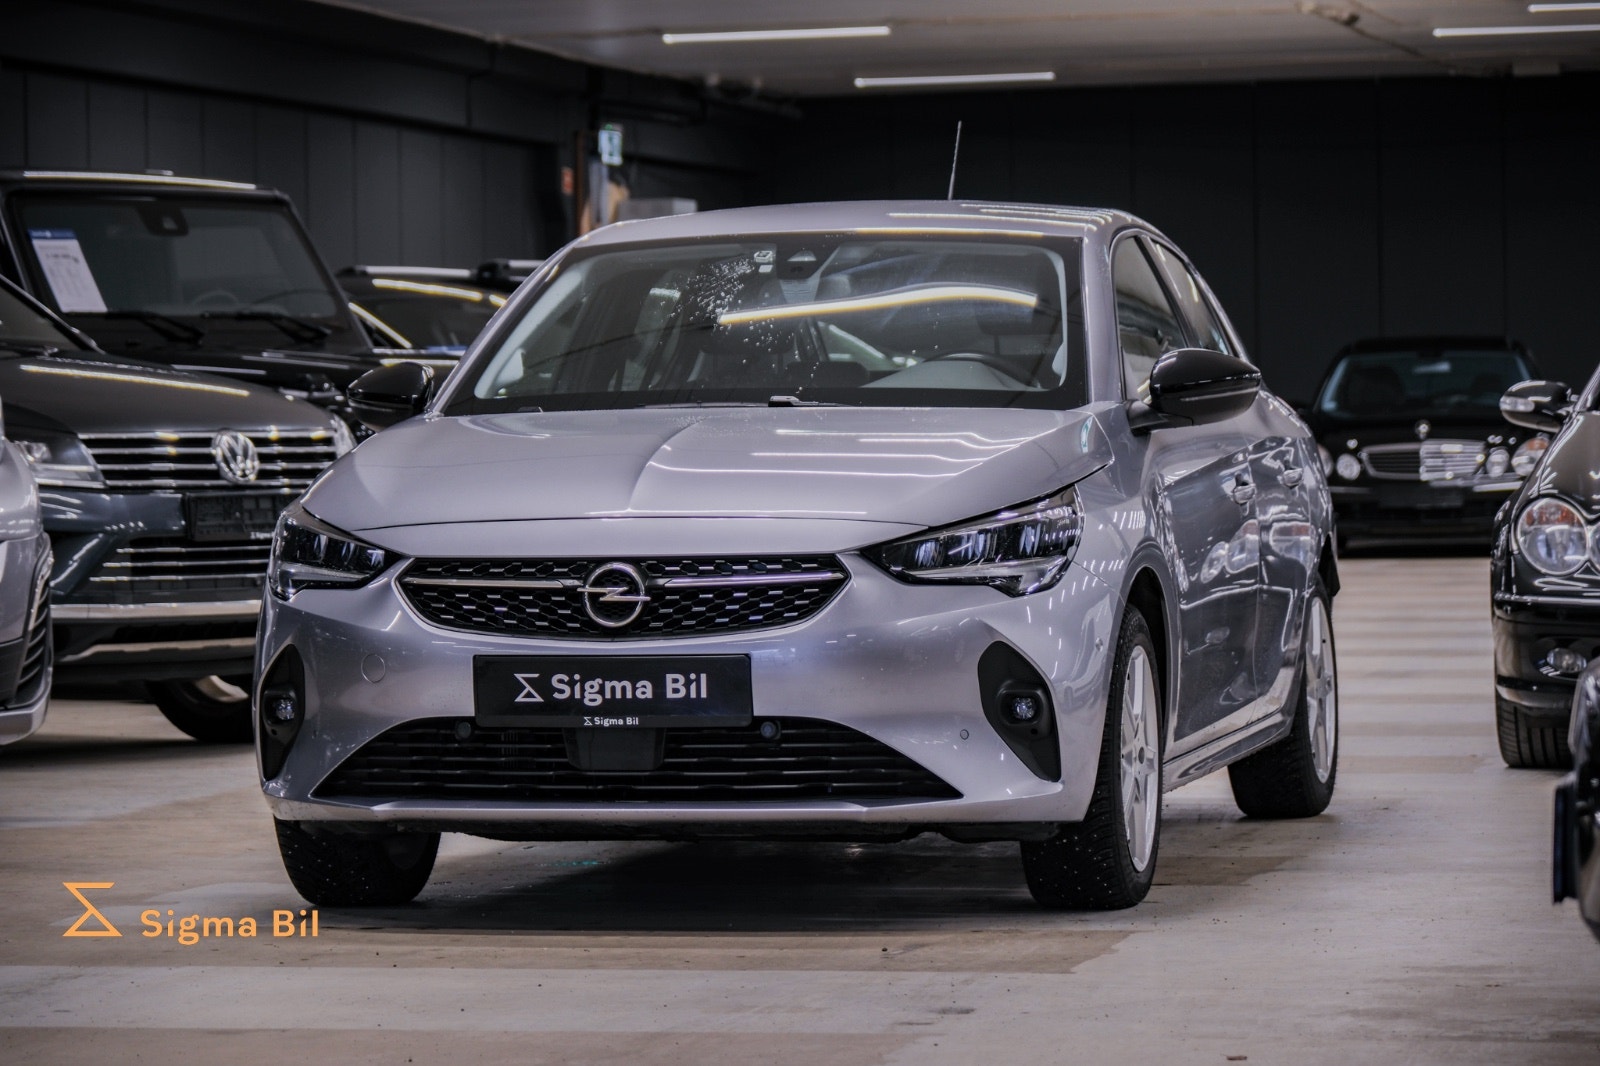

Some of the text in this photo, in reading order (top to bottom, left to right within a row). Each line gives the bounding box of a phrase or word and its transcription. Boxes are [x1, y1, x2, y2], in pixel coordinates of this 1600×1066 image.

[551, 673, 708, 707] Sigma Bil
[593, 716, 639, 727] Sigma Bil
